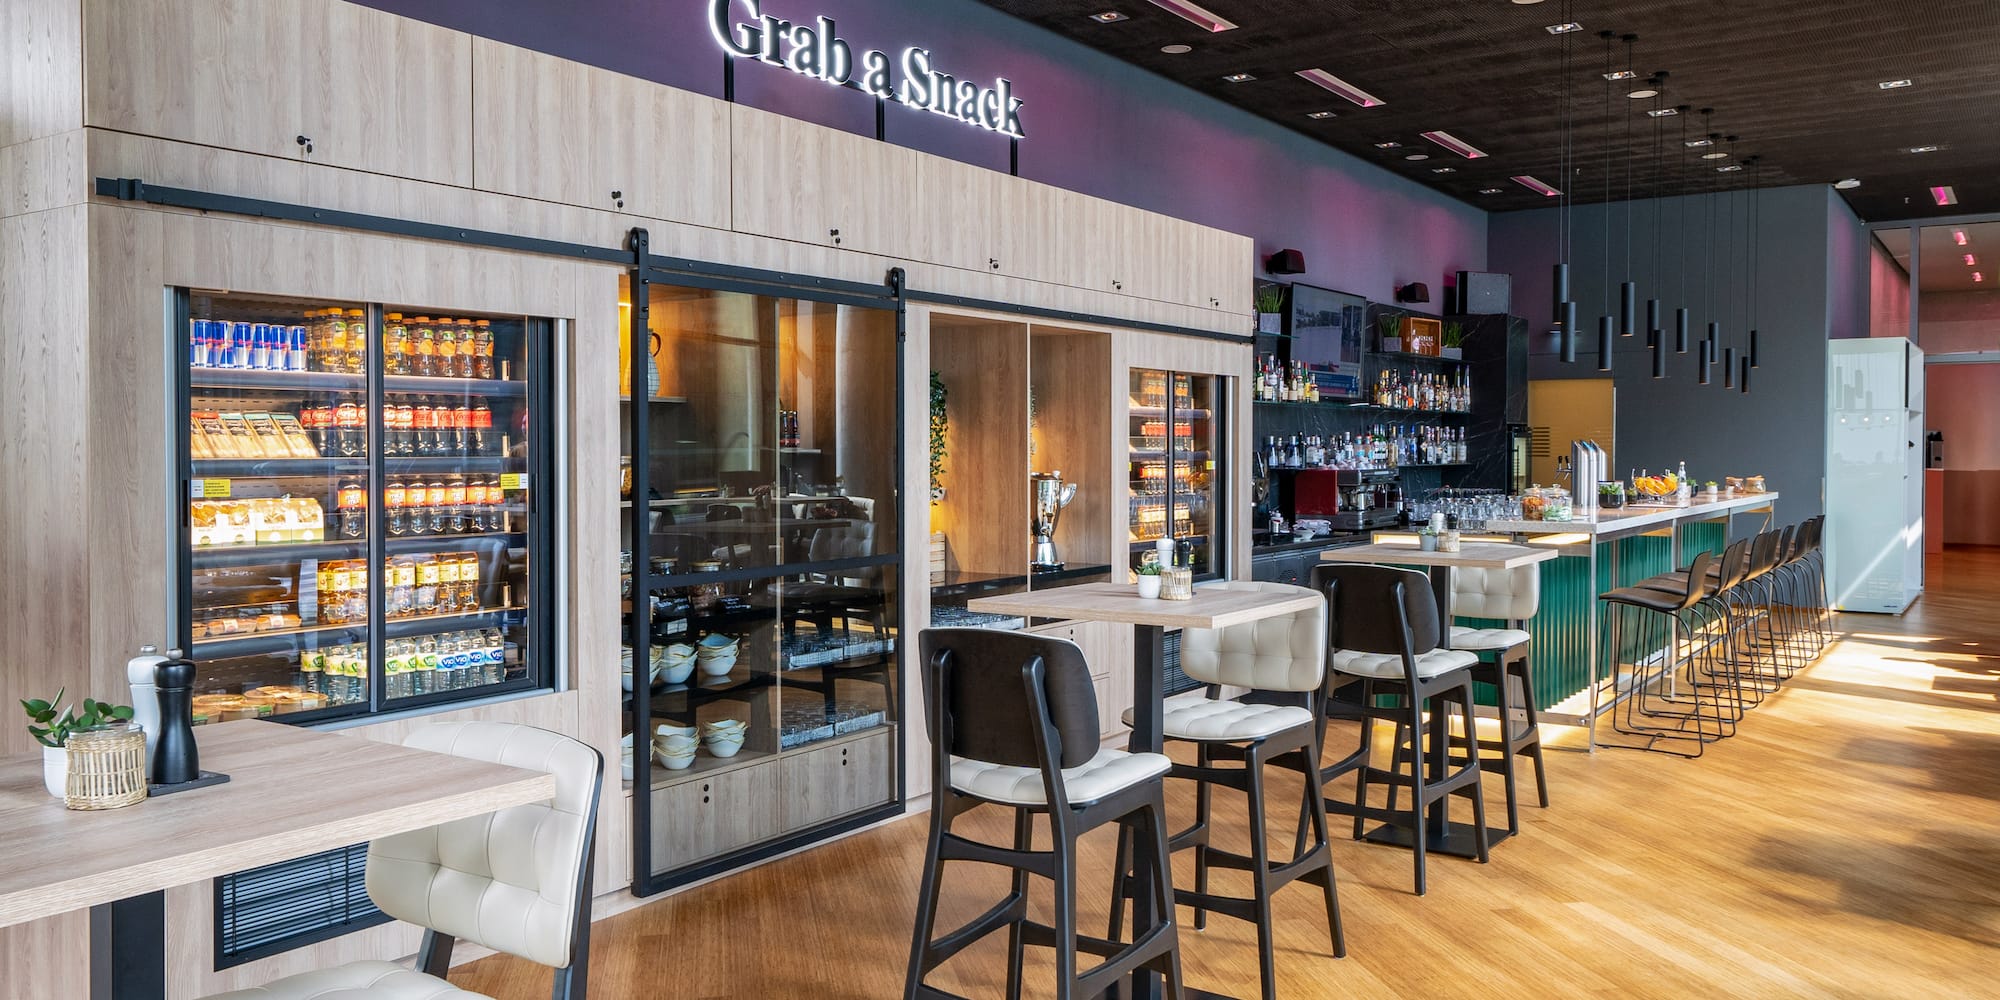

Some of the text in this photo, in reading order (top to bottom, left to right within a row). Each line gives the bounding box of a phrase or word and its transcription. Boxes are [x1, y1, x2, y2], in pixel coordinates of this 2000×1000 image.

[709, 0, 1025, 138] Grab a Snack
